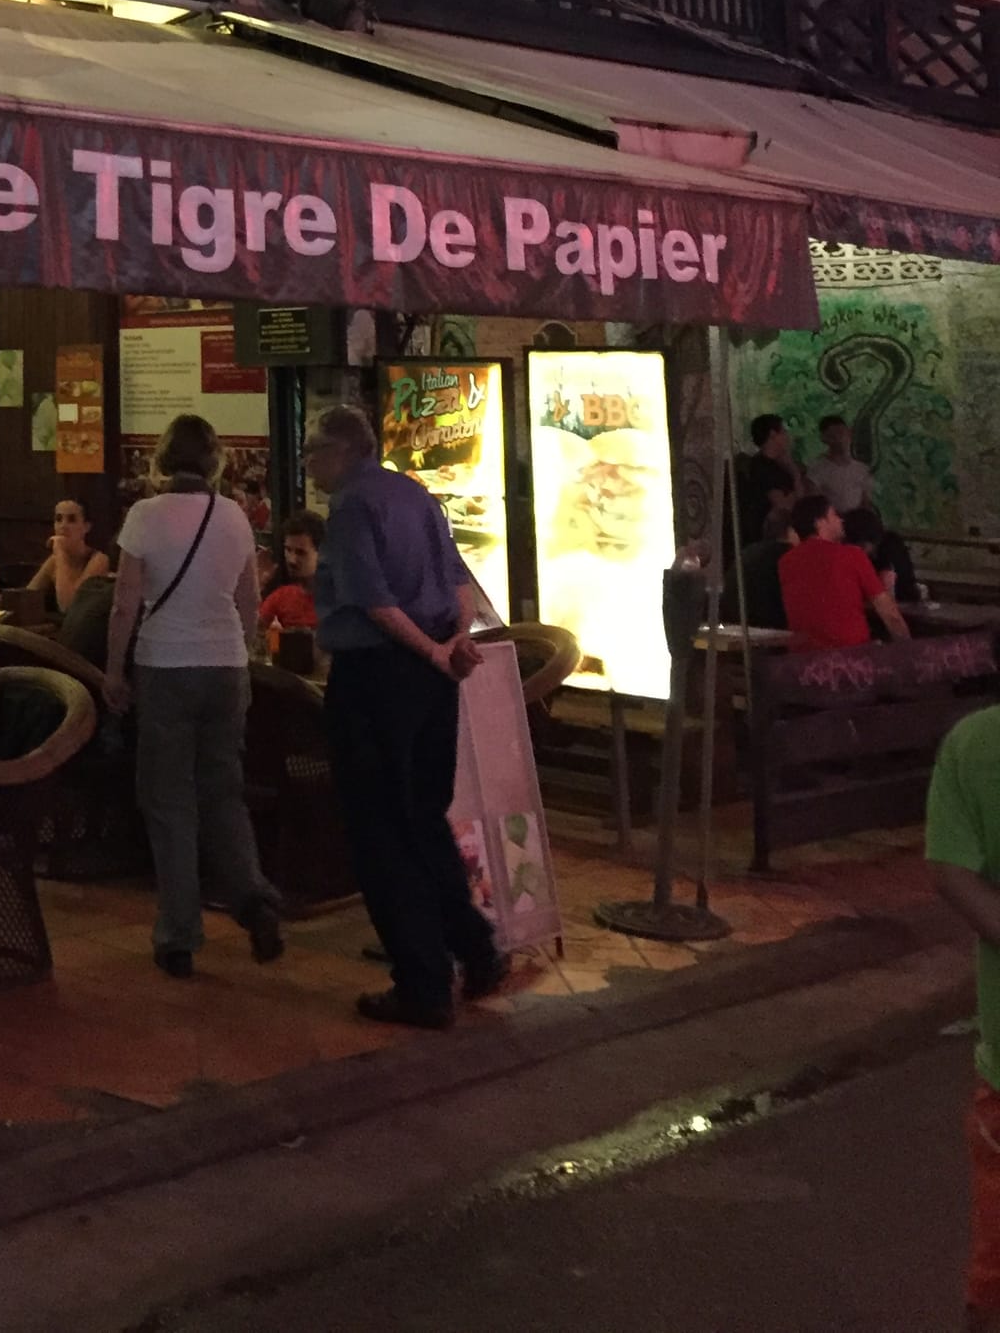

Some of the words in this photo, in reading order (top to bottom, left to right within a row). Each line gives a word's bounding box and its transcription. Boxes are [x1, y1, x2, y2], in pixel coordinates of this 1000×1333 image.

[72, 148, 338, 273] Tigre
[370, 183, 477, 267] De
[503, 197, 727, 296] Papier
[811, 307, 864, 342] ngkor
[392, 377, 462, 421] Pizza
[421, 368, 459, 391] Italian
